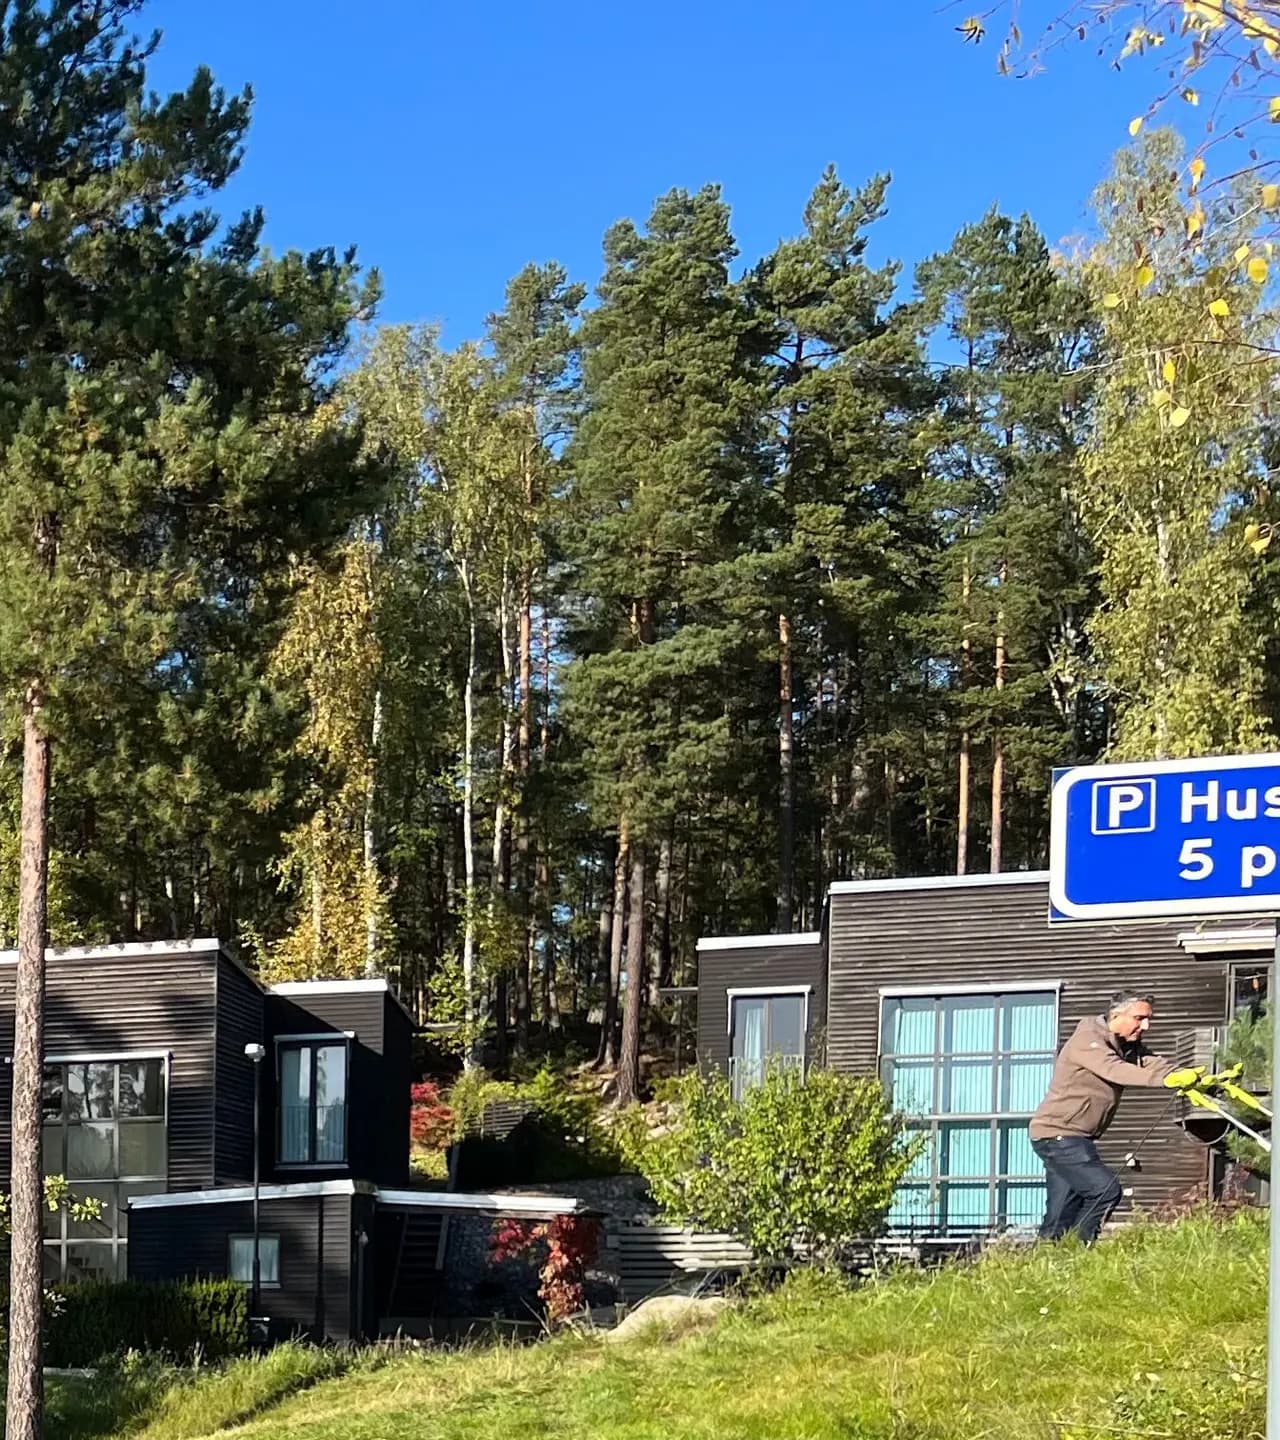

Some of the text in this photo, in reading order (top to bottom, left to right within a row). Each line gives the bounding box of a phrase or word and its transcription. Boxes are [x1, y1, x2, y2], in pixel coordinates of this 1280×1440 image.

[1108, 780, 1280, 828] P Hus
[1178, 838, 1278, 888] 5 p
